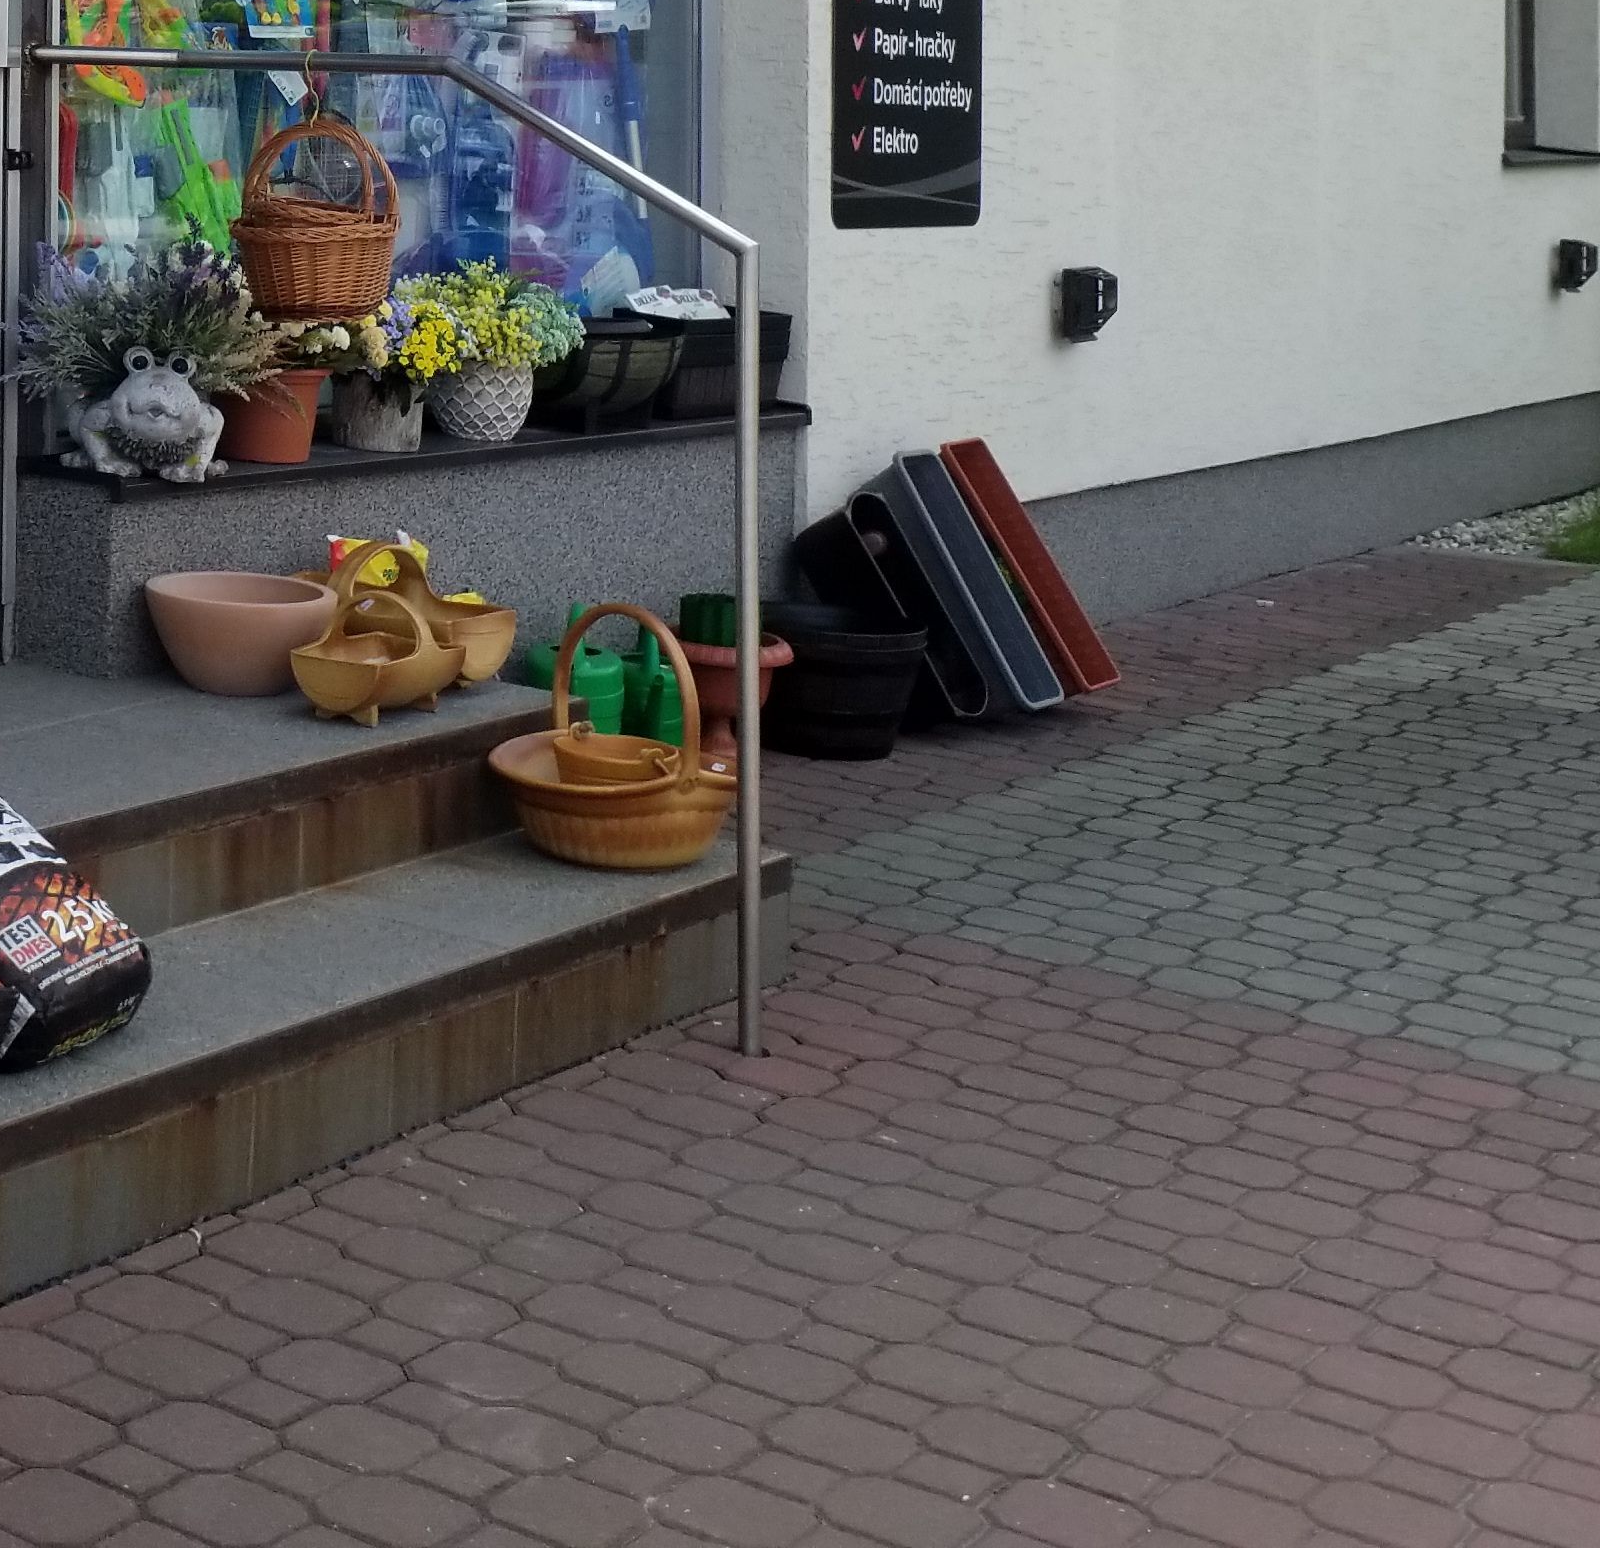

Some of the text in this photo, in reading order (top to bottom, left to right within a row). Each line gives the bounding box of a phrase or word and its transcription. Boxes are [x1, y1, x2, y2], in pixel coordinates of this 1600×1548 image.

[873, 77, 973, 113] Domácí potřeby
[873, 127, 919, 155] Elektro
[11, 935, 52, 967] DNES
